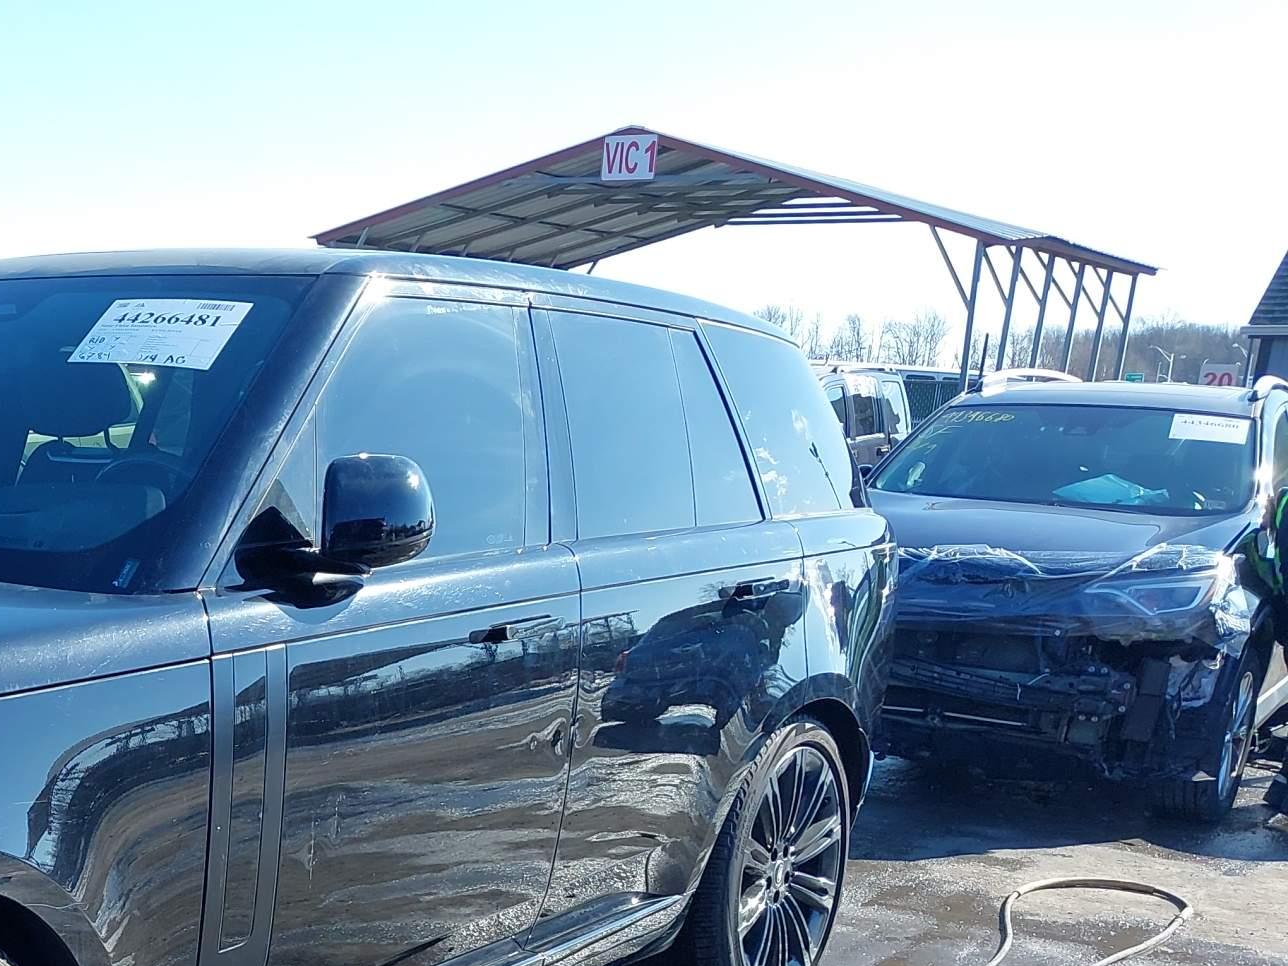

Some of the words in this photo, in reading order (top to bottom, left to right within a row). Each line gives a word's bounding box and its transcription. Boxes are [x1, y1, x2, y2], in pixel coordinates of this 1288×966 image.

[605, 140, 639, 174] VIC
[645, 140, 656, 173] 1
[113, 311, 222, 327] 44266481
[1203, 372, 1233, 386] 20
